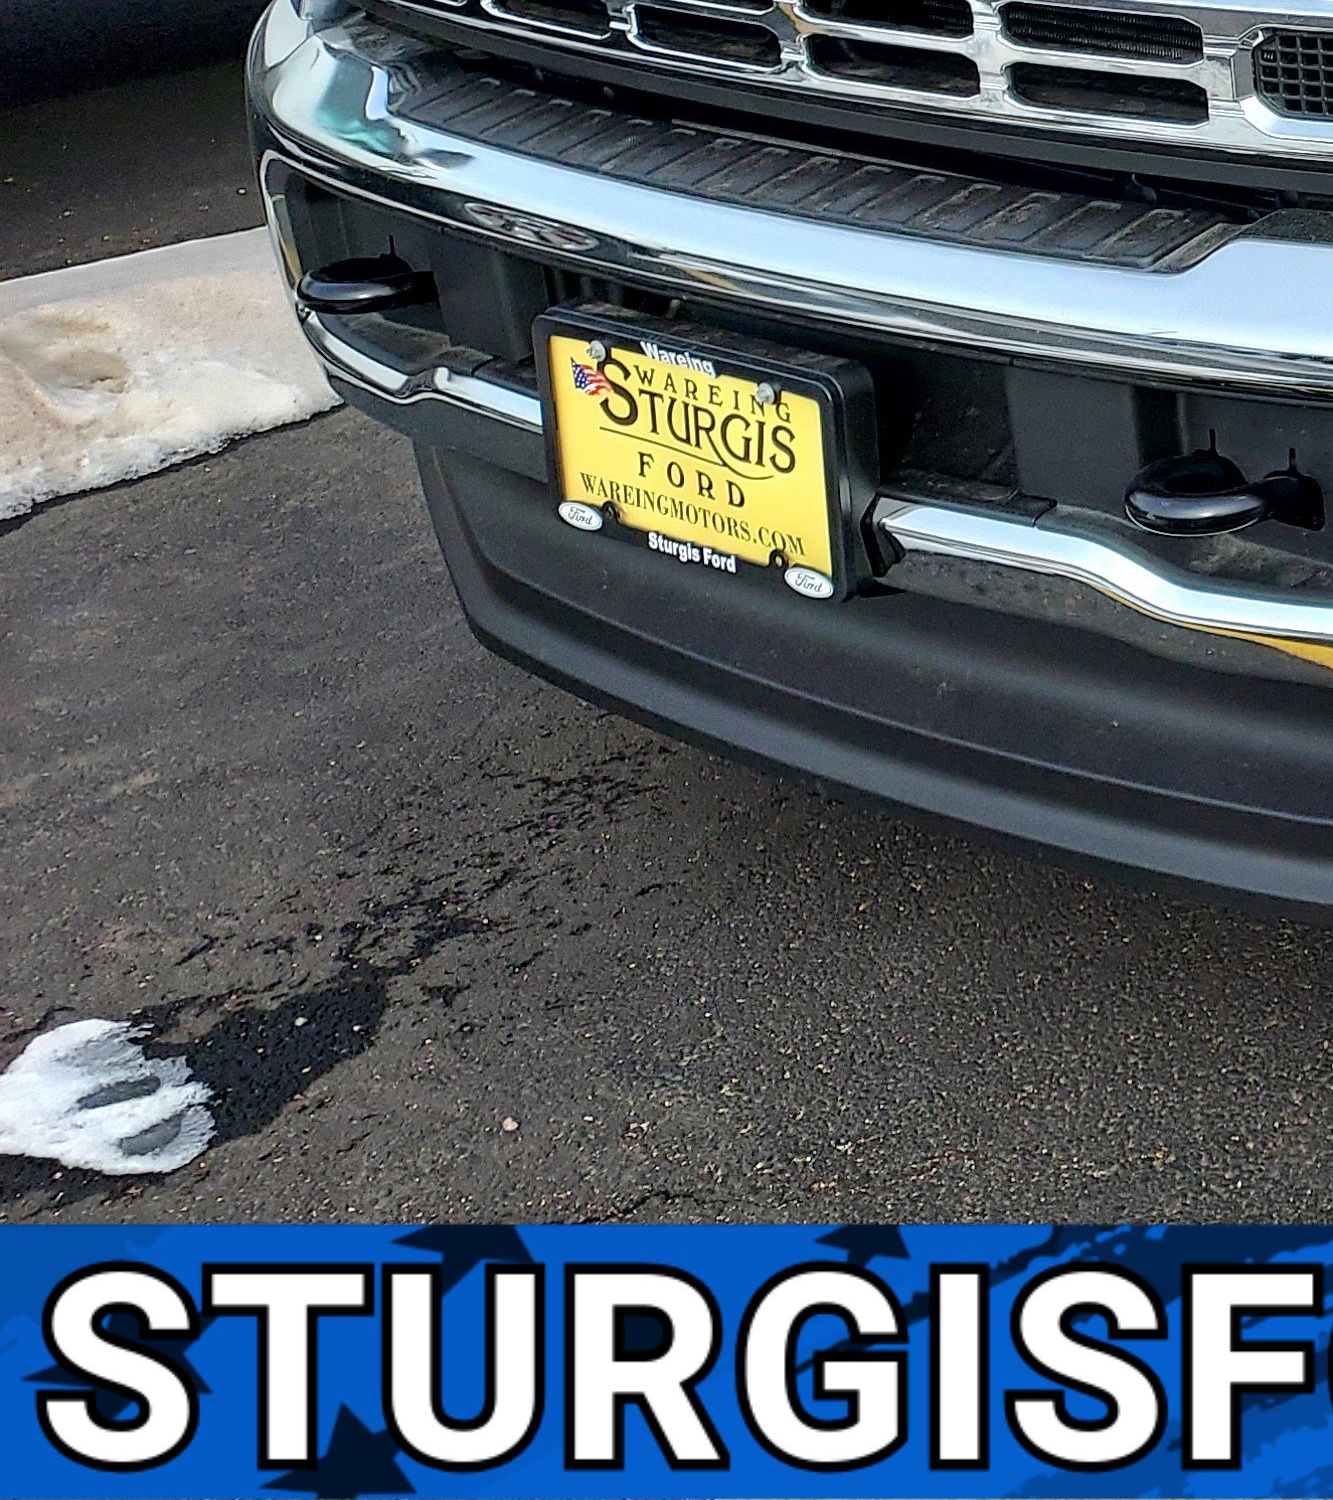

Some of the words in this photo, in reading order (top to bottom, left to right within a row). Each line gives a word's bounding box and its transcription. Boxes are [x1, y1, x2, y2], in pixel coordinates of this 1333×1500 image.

[640, 341, 717, 378] Wareing
[633, 364, 792, 424] WAREING
[600, 358, 796, 480] STURGIS
[637, 451, 746, 508] FORD
[567, 507, 594, 526] Ford
[580, 472, 805, 556] WAREINGMOTORS.COM
[648, 532, 701, 564] Sturgis
[703, 548, 737, 574] Ford
[795, 574, 823, 593] Ford
